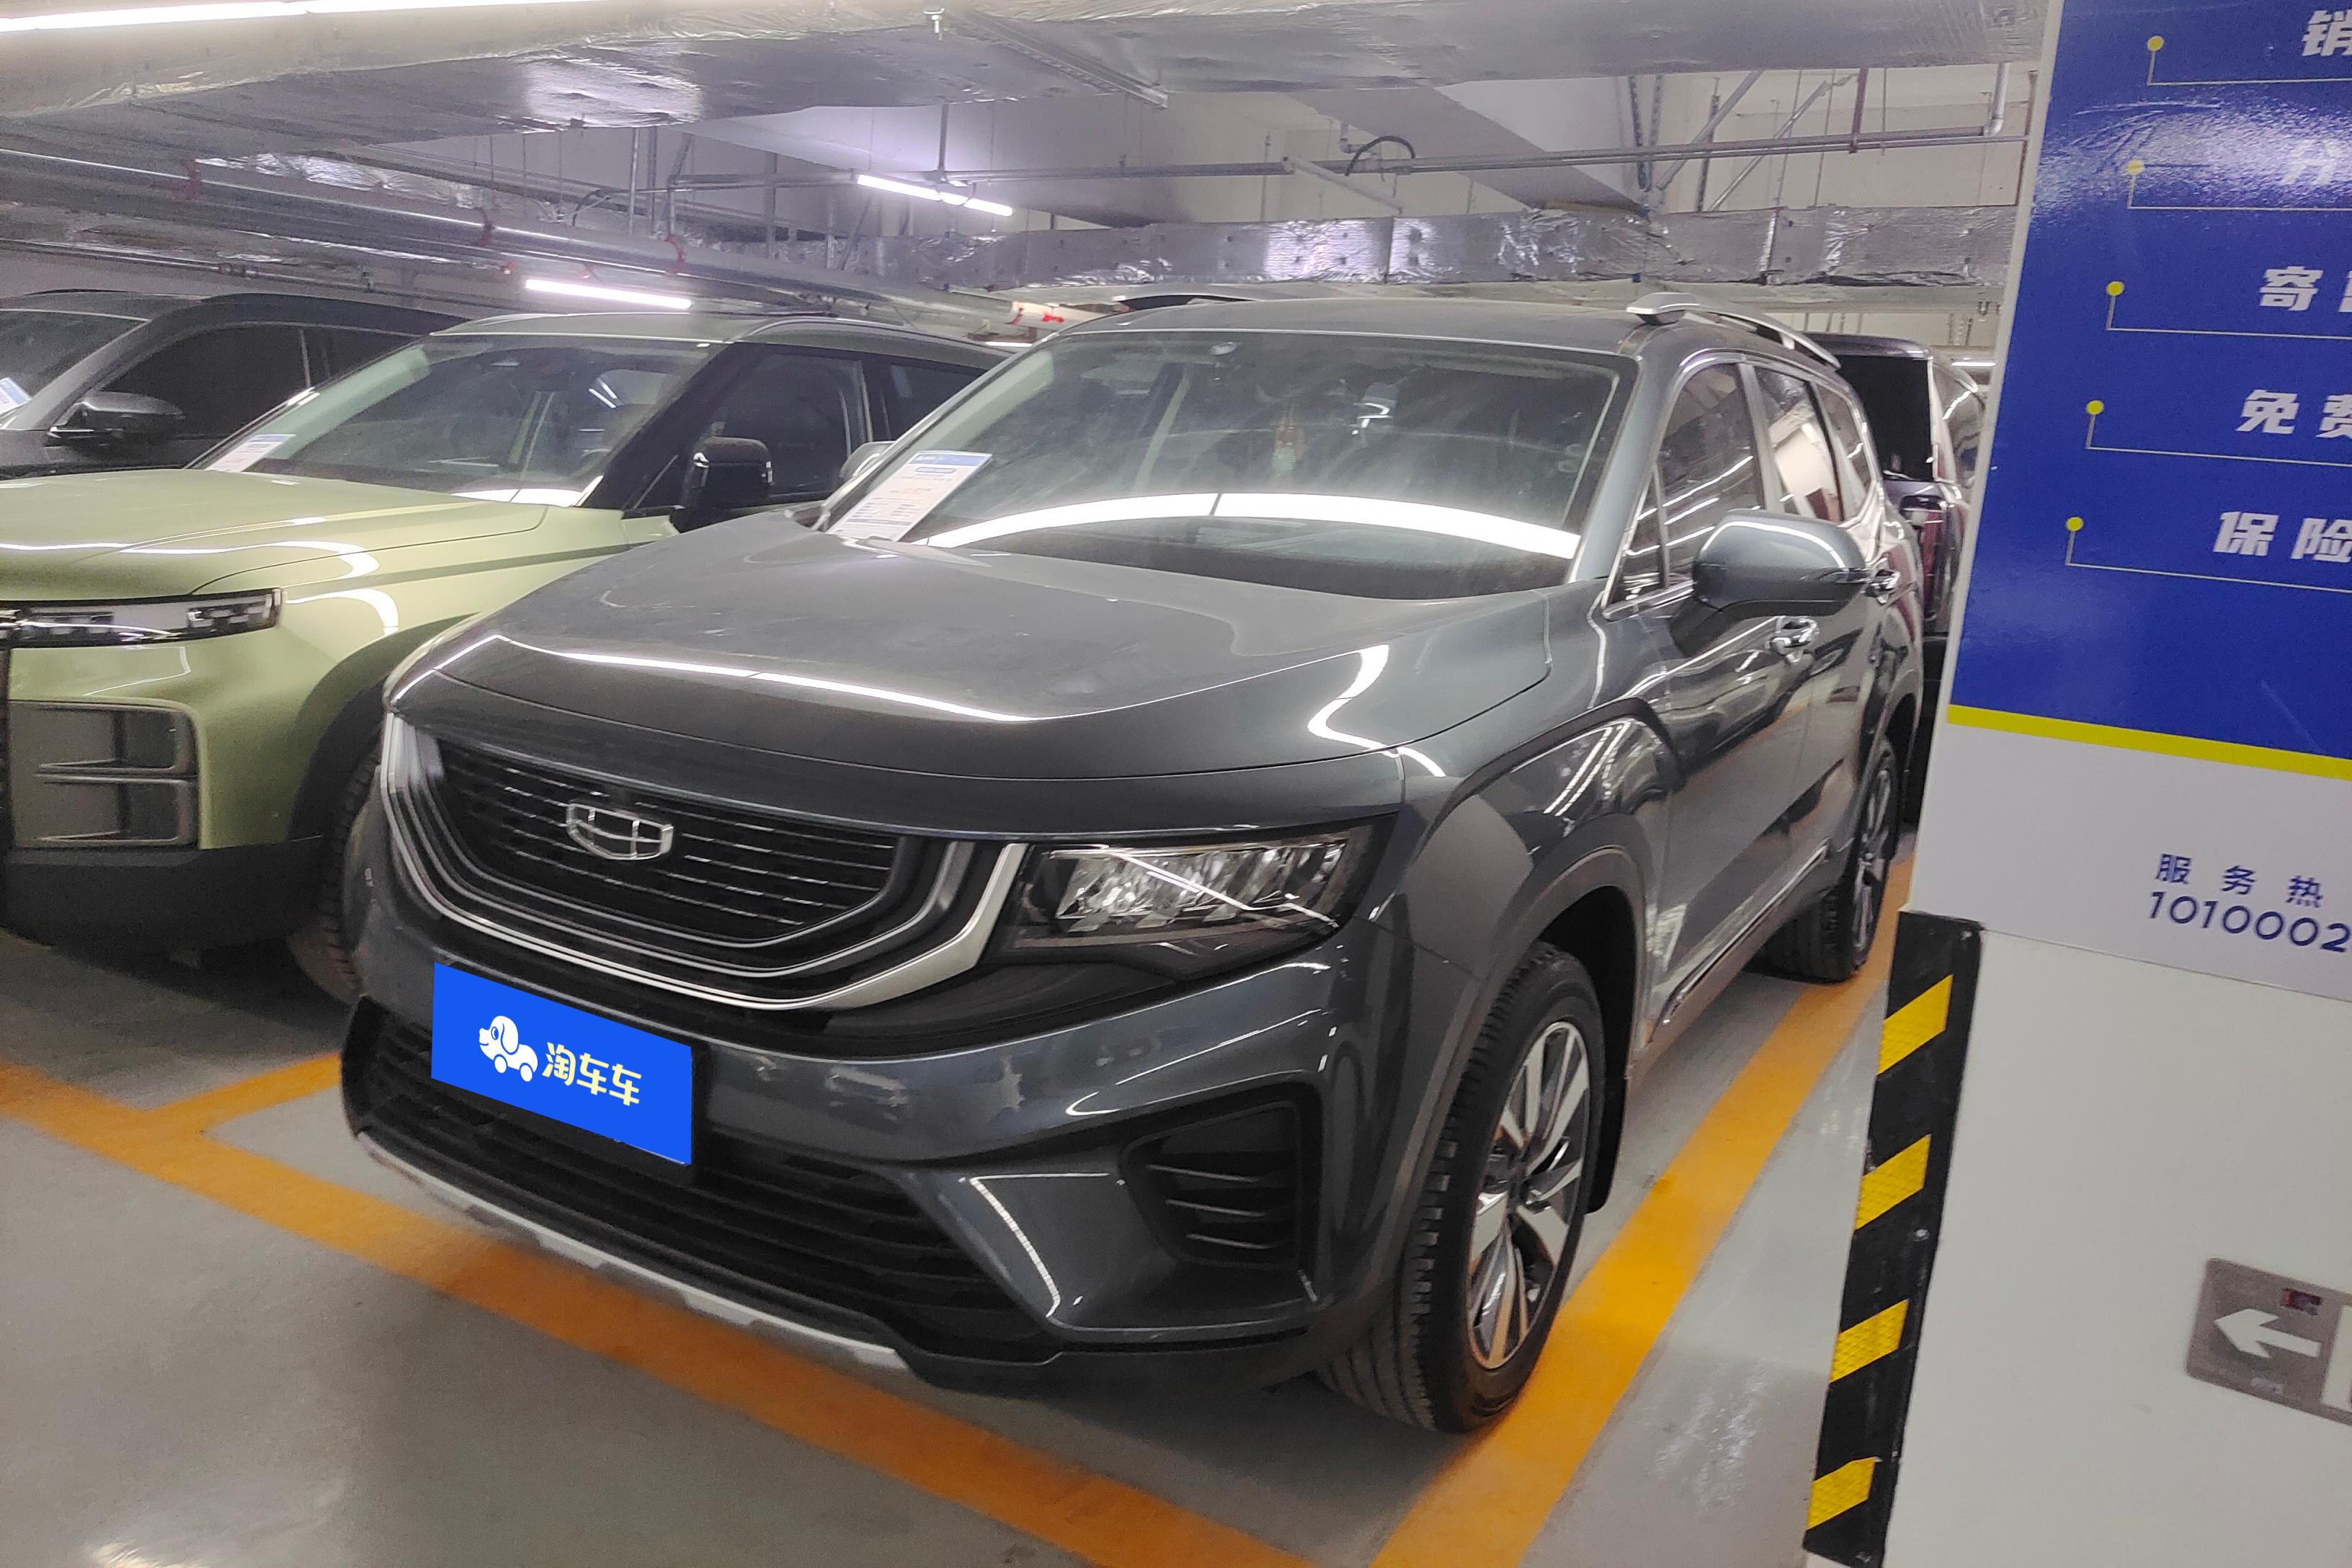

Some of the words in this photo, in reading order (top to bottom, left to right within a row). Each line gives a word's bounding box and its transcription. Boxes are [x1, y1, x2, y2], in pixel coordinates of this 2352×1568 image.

[2260, 266, 2352, 313] 寄
[2213, 511, 2352, 563] 保险
[2155, 853, 2323, 908] 服务热
[2150, 891, 2351, 953] 1010002
